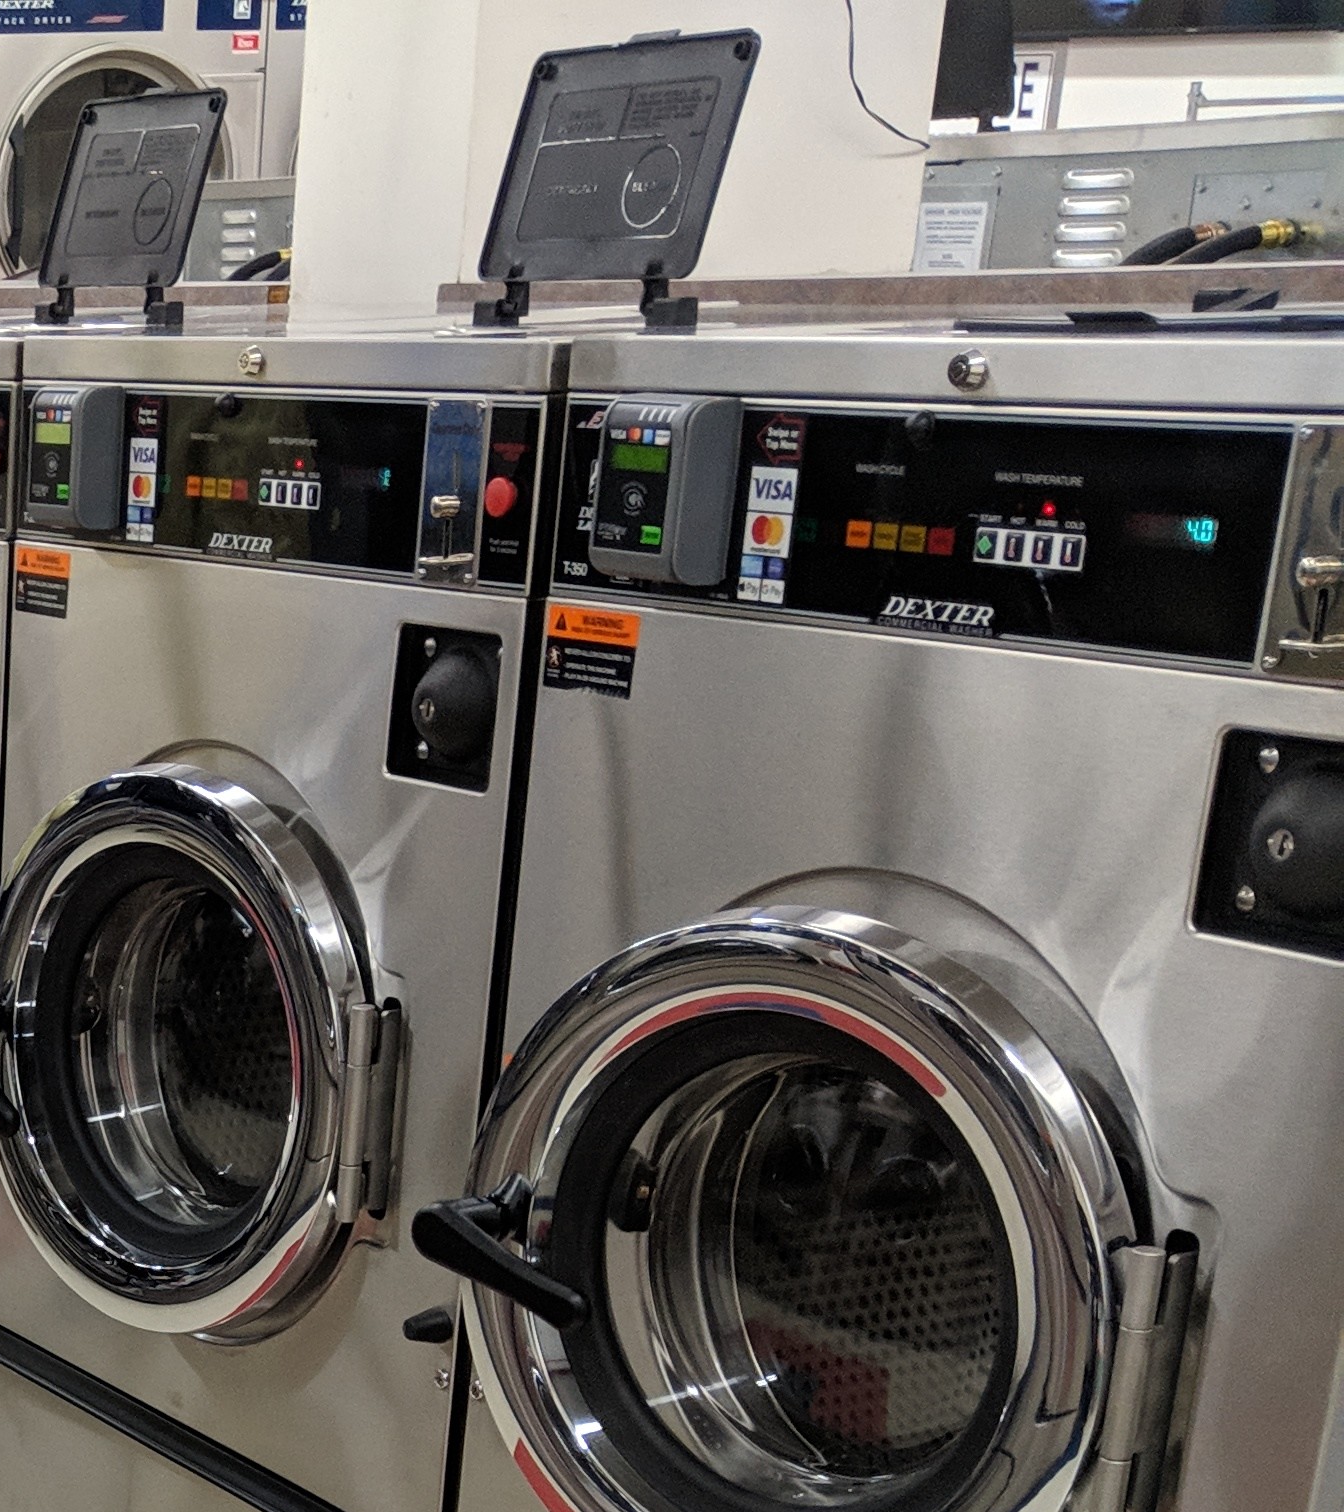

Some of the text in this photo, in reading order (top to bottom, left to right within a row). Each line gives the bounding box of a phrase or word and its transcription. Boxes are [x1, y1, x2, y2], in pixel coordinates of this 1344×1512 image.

[133, 446, 155, 463] VISA
[753, 478, 793, 499] VISA
[1022, 473, 1084, 488] TEMPERATURE
[208, 532, 273, 553] DEXTER
[563, 561, 588, 576] T-350
[879, 596, 995, 627] DEXTER
[877, 616, 942, 632] COMMERCIAL
